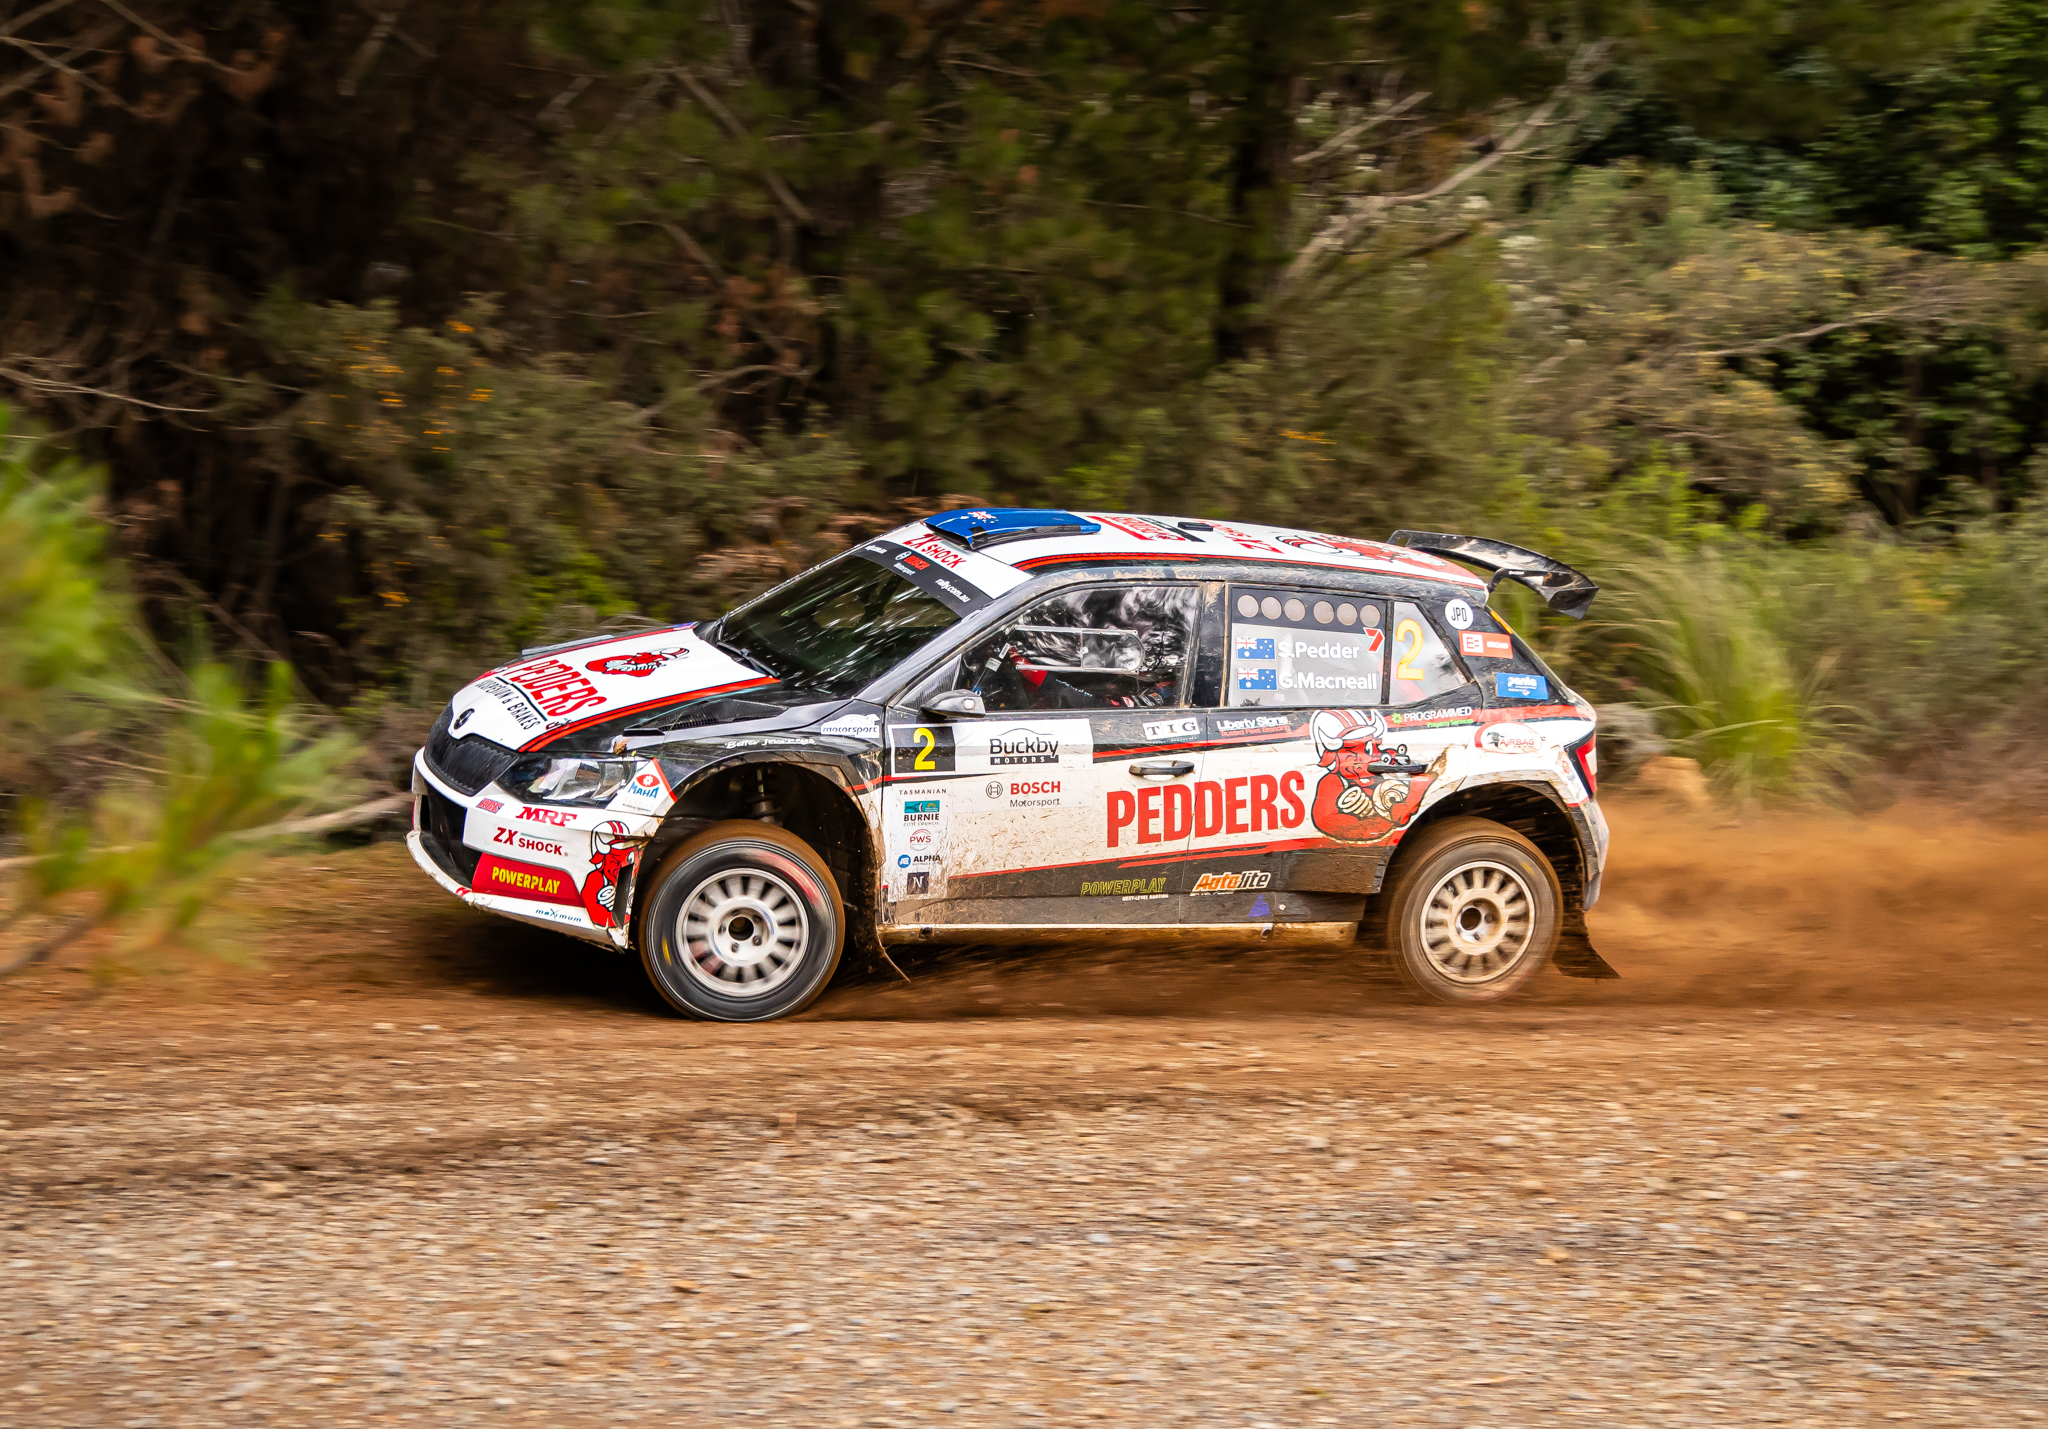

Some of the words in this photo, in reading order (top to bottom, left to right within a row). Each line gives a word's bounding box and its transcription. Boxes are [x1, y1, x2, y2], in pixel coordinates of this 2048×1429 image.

[902, 533, 943, 549] ZX
[921, 544, 967, 568] SHOCK
[935, 578, 971, 603] rally.com.au
[1277, 641, 1360, 659] S.Pedder
[1395, 618, 1425, 681] 2
[502, 659, 607, 717] PEDDERS
[1278, 672, 1378, 690] G.Macneall
[507, 702, 541, 730] BRAKES
[1216, 718, 1256, 730] Liberty
[1256, 716, 1289, 728] Signs
[1403, 706, 1472, 722] PROGRAMMED
[822, 725, 878, 736] motorsport
[912, 727, 936, 770] 2
[989, 737, 1059, 757] Buckby
[1499, 738, 1535, 747] AIRBAG
[994, 756, 1045, 764] MOTORS
[628, 781, 660, 798] MAHA
[899, 788, 947, 796] TASMANIAN
[1010, 781, 1061, 795] BOSCH
[1009, 798, 1060, 808] Motorsport
[1106, 770, 1306, 848] PEDDERS
[515, 806, 577, 827] MRF
[903, 813, 940, 822] BURNIE
[493, 827, 519, 846] ZX
[518, 838, 563, 856] SHOCK
[909, 835, 931, 844] PWS
[913, 855, 941, 863] ALPHA
[491, 866, 561, 895] POWERPLAY
[1080, 877, 1166, 896] POWERPLAY
[1192, 870, 1271, 892] Autolite
